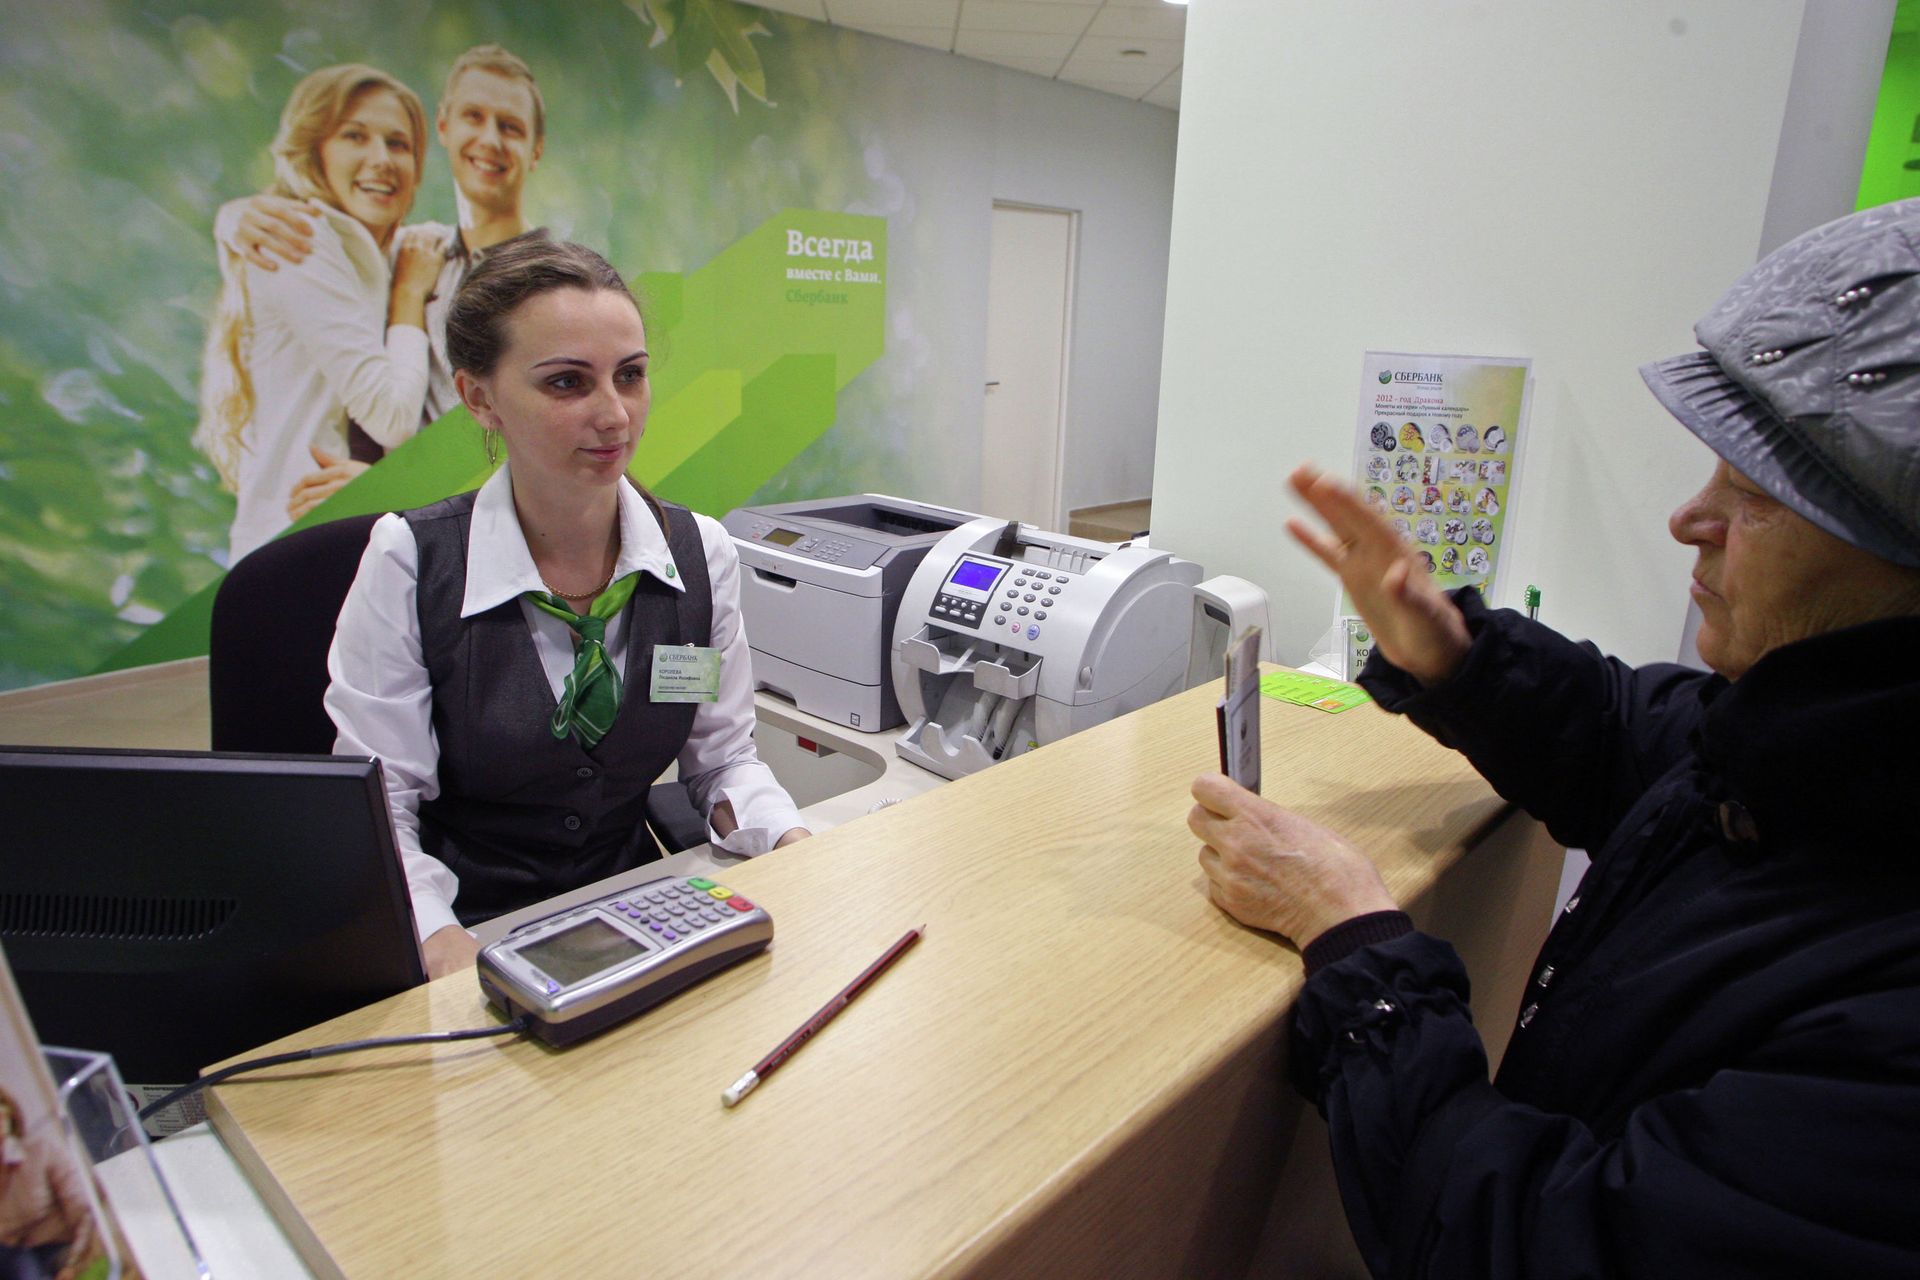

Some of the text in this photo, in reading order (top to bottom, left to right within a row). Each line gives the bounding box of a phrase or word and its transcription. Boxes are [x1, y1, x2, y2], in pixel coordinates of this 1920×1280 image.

[786, 229, 874, 264] Всегда
[786, 268, 882, 284] вместе с Вами.
[786, 288, 848, 306] Сбербанк
[1394, 372, 1443, 382] СБЕРБАНК
[1375, 394, 1393, 403] 2012
[1399, 396, 1412, 404] год
[1413, 396, 1444, 404] Дракона
[1356, 649, 1370, 657] КО
